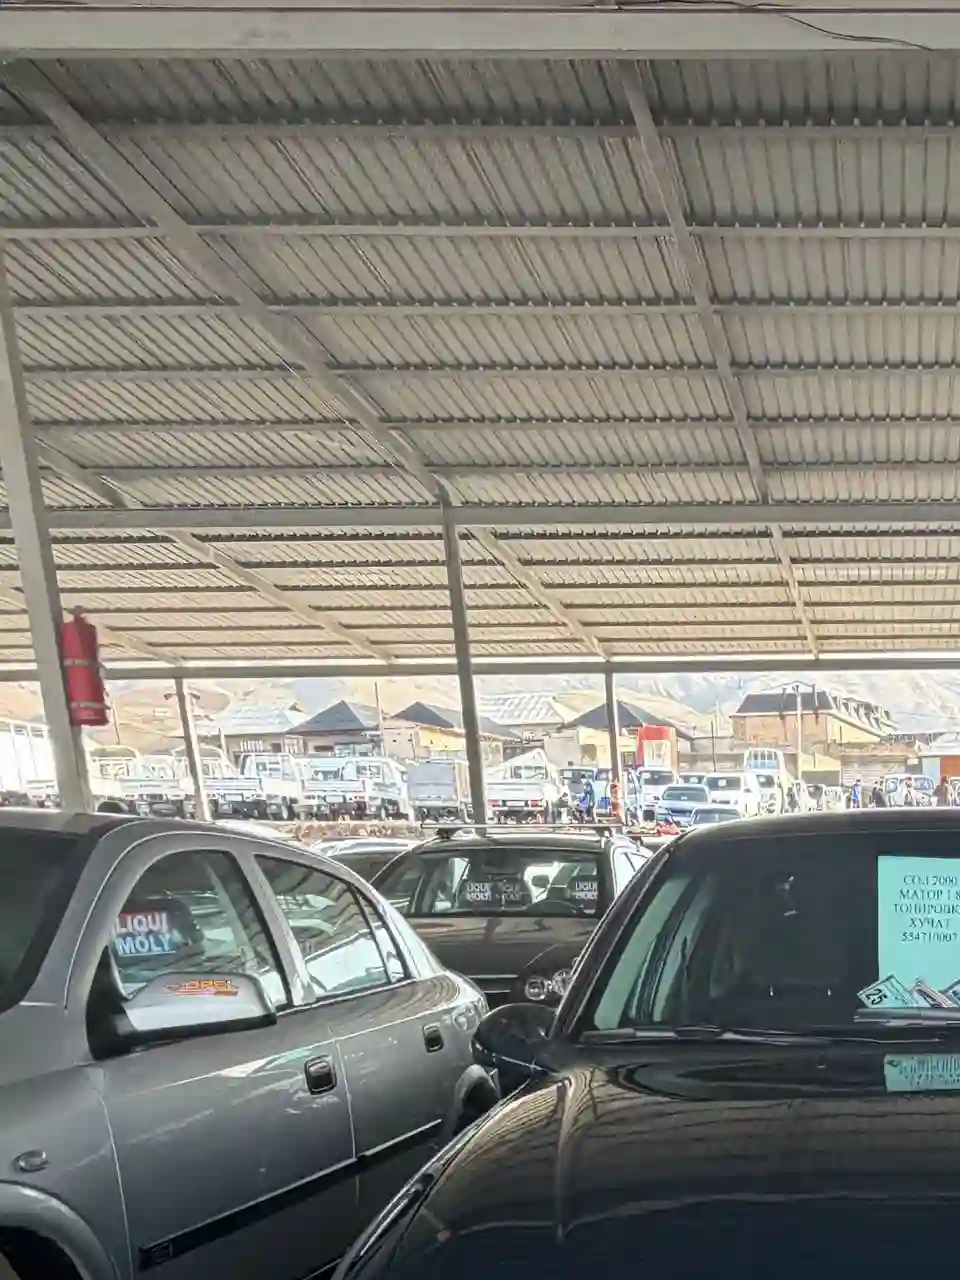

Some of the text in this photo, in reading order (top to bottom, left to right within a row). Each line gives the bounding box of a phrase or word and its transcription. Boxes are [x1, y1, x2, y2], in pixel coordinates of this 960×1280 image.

[931, 875, 957, 886] 2000
[115, 912, 169, 935] LIQUI
[115, 933, 171, 954] MOLY
[865, 988, 887, 1005] 25
